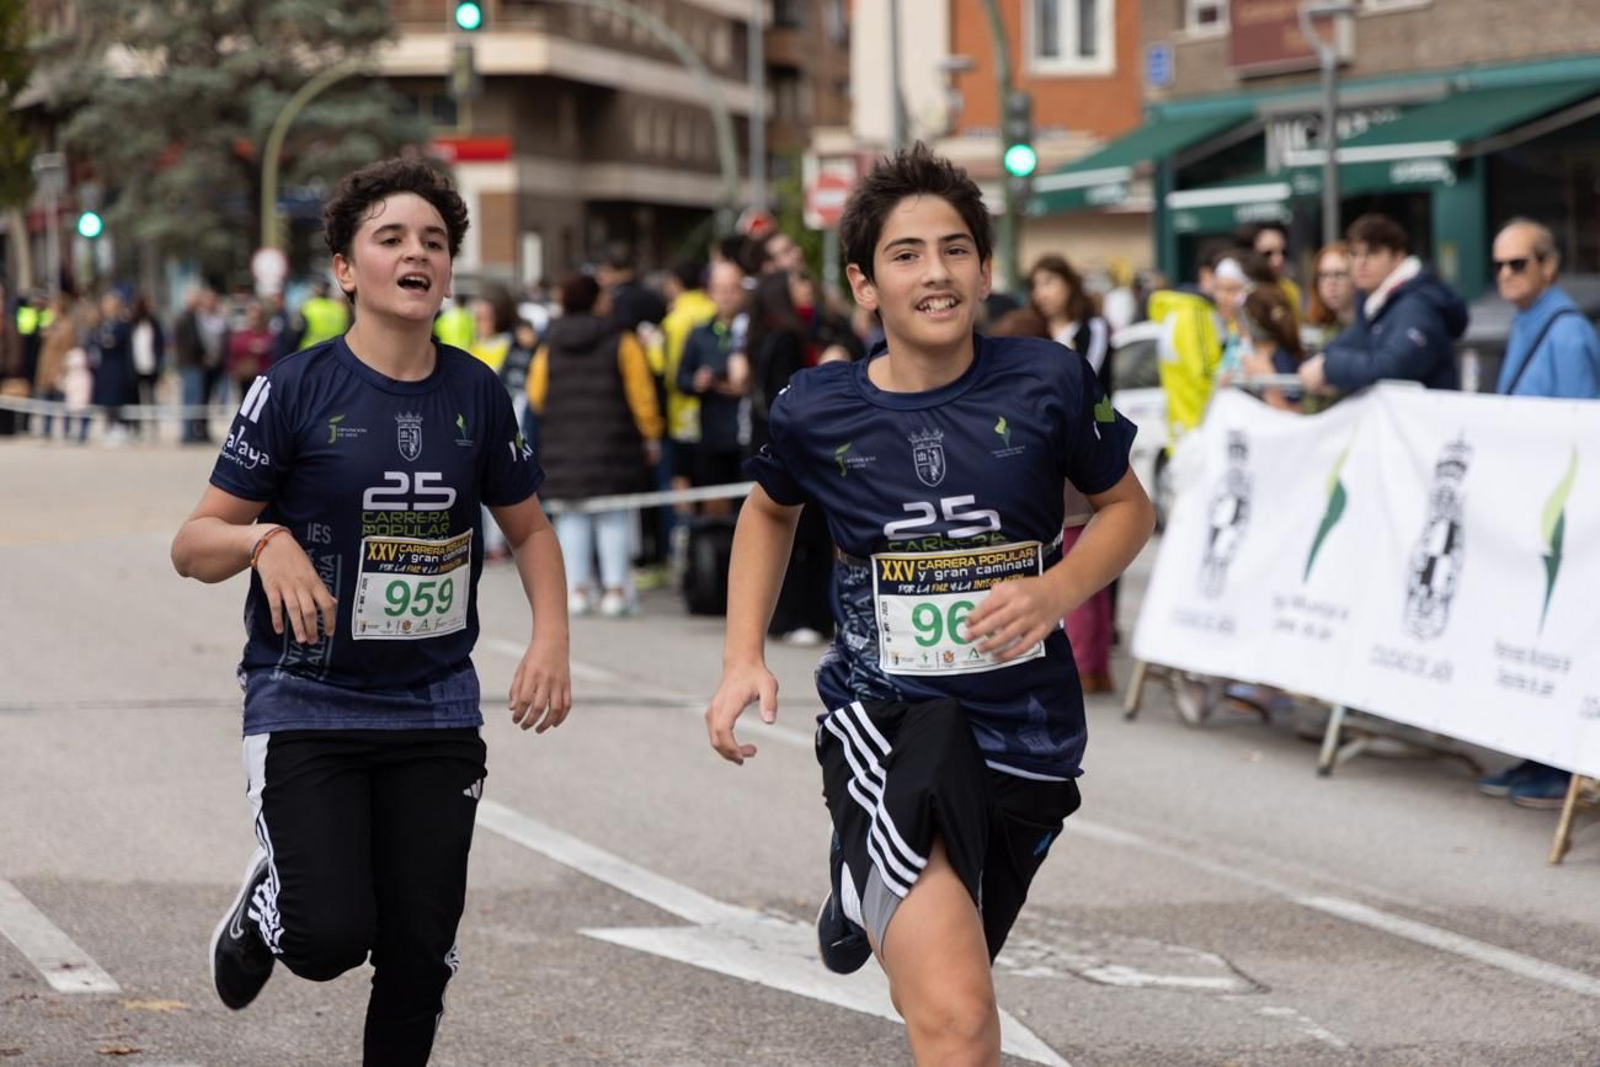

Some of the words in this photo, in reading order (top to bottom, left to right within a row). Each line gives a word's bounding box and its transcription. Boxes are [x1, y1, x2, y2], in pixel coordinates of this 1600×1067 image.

[224, 425, 270, 469] alaya
[362, 471, 457, 511] 25
[361, 511, 451, 524] CARRERA
[361, 522, 450, 537] POPULAR
[883, 494, 1002, 541] 25
[306, 521, 332, 545] IES
[367, 542, 398, 561] XXV
[400, 544, 445, 555] CARRERA
[398, 554, 406, 562] y
[411, 554, 439, 564] gran
[881, 560, 915, 582] XXV
[917, 557, 976, 571] CARRERA
[978, 549, 1036, 565] POPULAR
[918, 570, 927, 582] y
[934, 567, 969, 581] gran
[976, 558, 1035, 576] caminata
[383, 578, 454, 617] 959
[911, 599, 978, 647] 96
